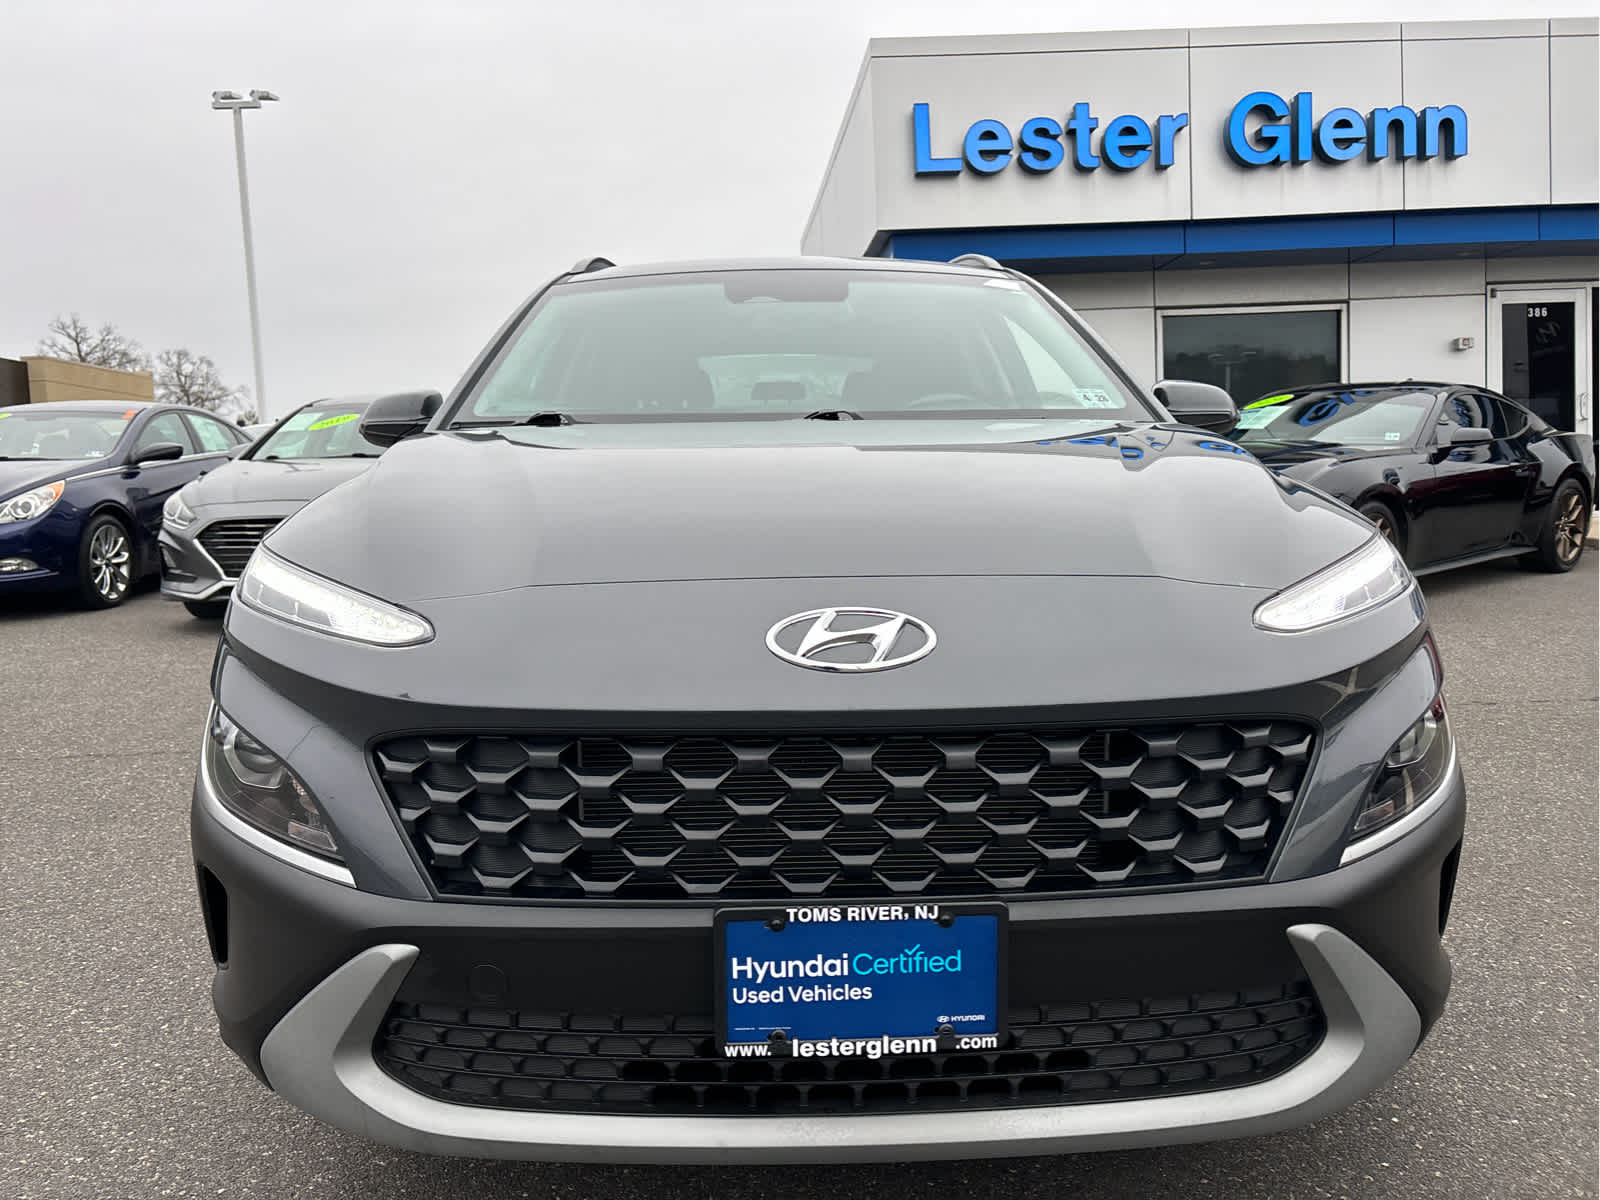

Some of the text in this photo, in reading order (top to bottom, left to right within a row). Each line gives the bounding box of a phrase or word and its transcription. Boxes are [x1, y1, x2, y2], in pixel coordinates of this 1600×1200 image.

[913, 90, 1468, 176] Lester Glenn
[1527, 307, 1548, 317] 386
[786, 905, 939, 923] TOMS RIVER, NJ
[731, 944, 962, 984] Hyundai Certified
[732, 983, 873, 1005] Used Vehicles
[724, 1035, 998, 1060] www. lesterglenn .com
